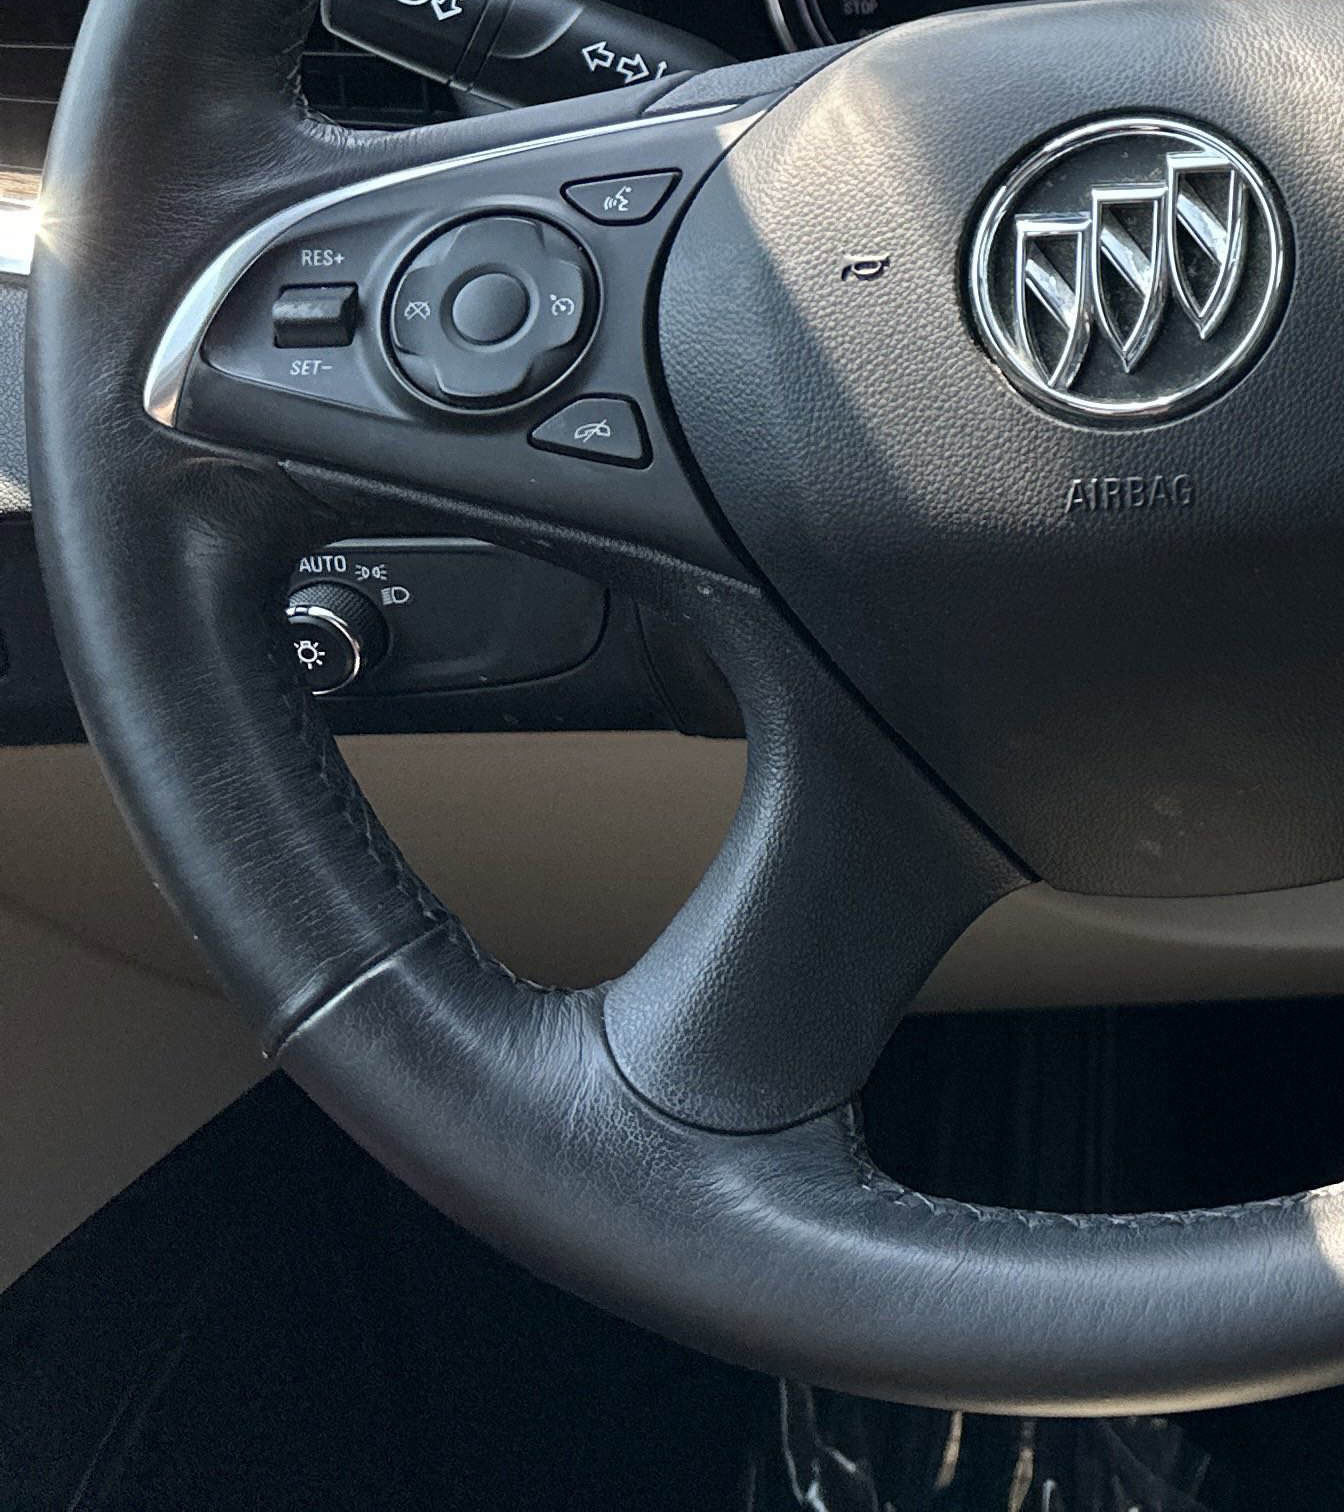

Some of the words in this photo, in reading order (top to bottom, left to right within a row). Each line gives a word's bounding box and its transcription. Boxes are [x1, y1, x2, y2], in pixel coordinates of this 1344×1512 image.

[844, 0, 878, 15] STOP
[302, 249, 344, 266] RES+
[1065, 474, 1194, 514] AIRBAG
[300, 555, 346, 573] AUTO
